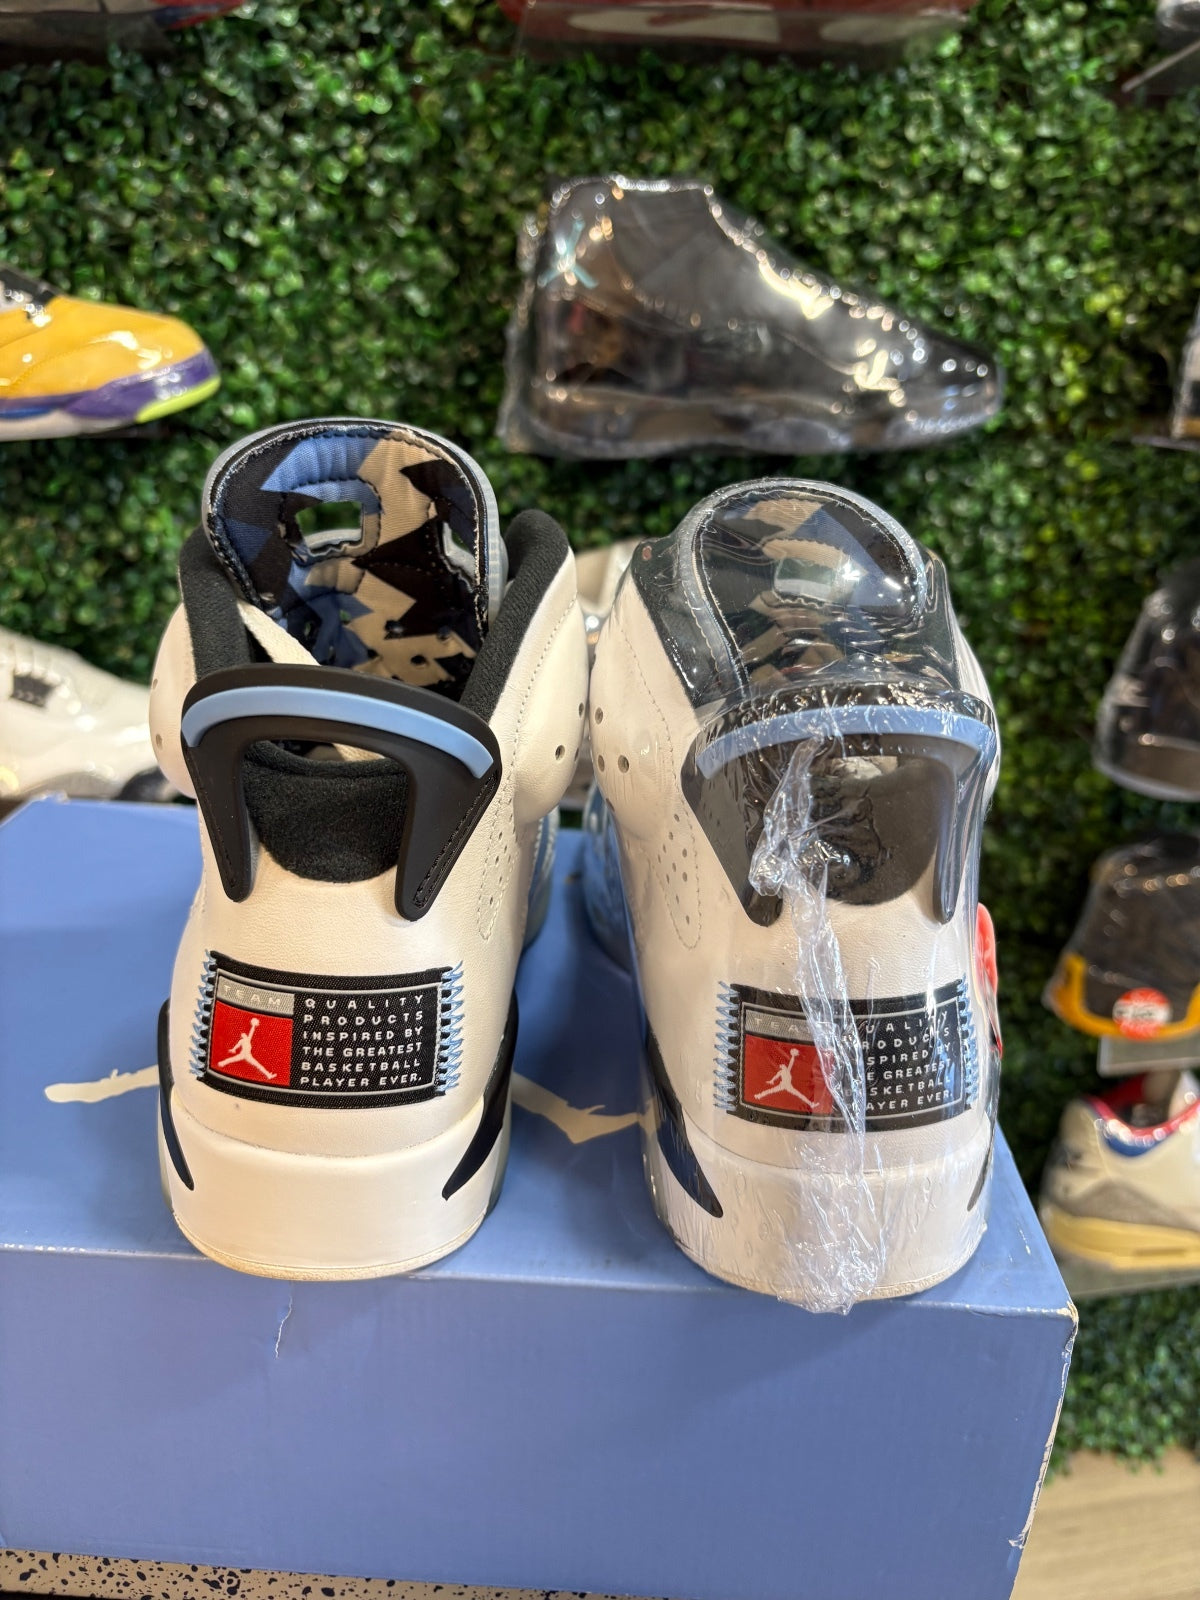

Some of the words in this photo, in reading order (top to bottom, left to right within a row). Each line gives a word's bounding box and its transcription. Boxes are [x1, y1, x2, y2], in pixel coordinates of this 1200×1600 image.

[224, 984, 281, 1005] TEAM
[305, 994, 423, 1009] QUALITY
[303, 1011, 423, 1026] PRODUCTS
[754, 1017, 812, 1036] TEA
[303, 1030, 395, 1042] INSPIRED
[404, 1026, 423, 1038] BY
[302, 1046, 335, 1057] THE
[343, 1042, 422, 1058] GREATEST
[301, 1059, 421, 1072] BASKETBALL
[883, 1058, 951, 1080] GREATEST
[300, 1076, 370, 1087] PLAYER
